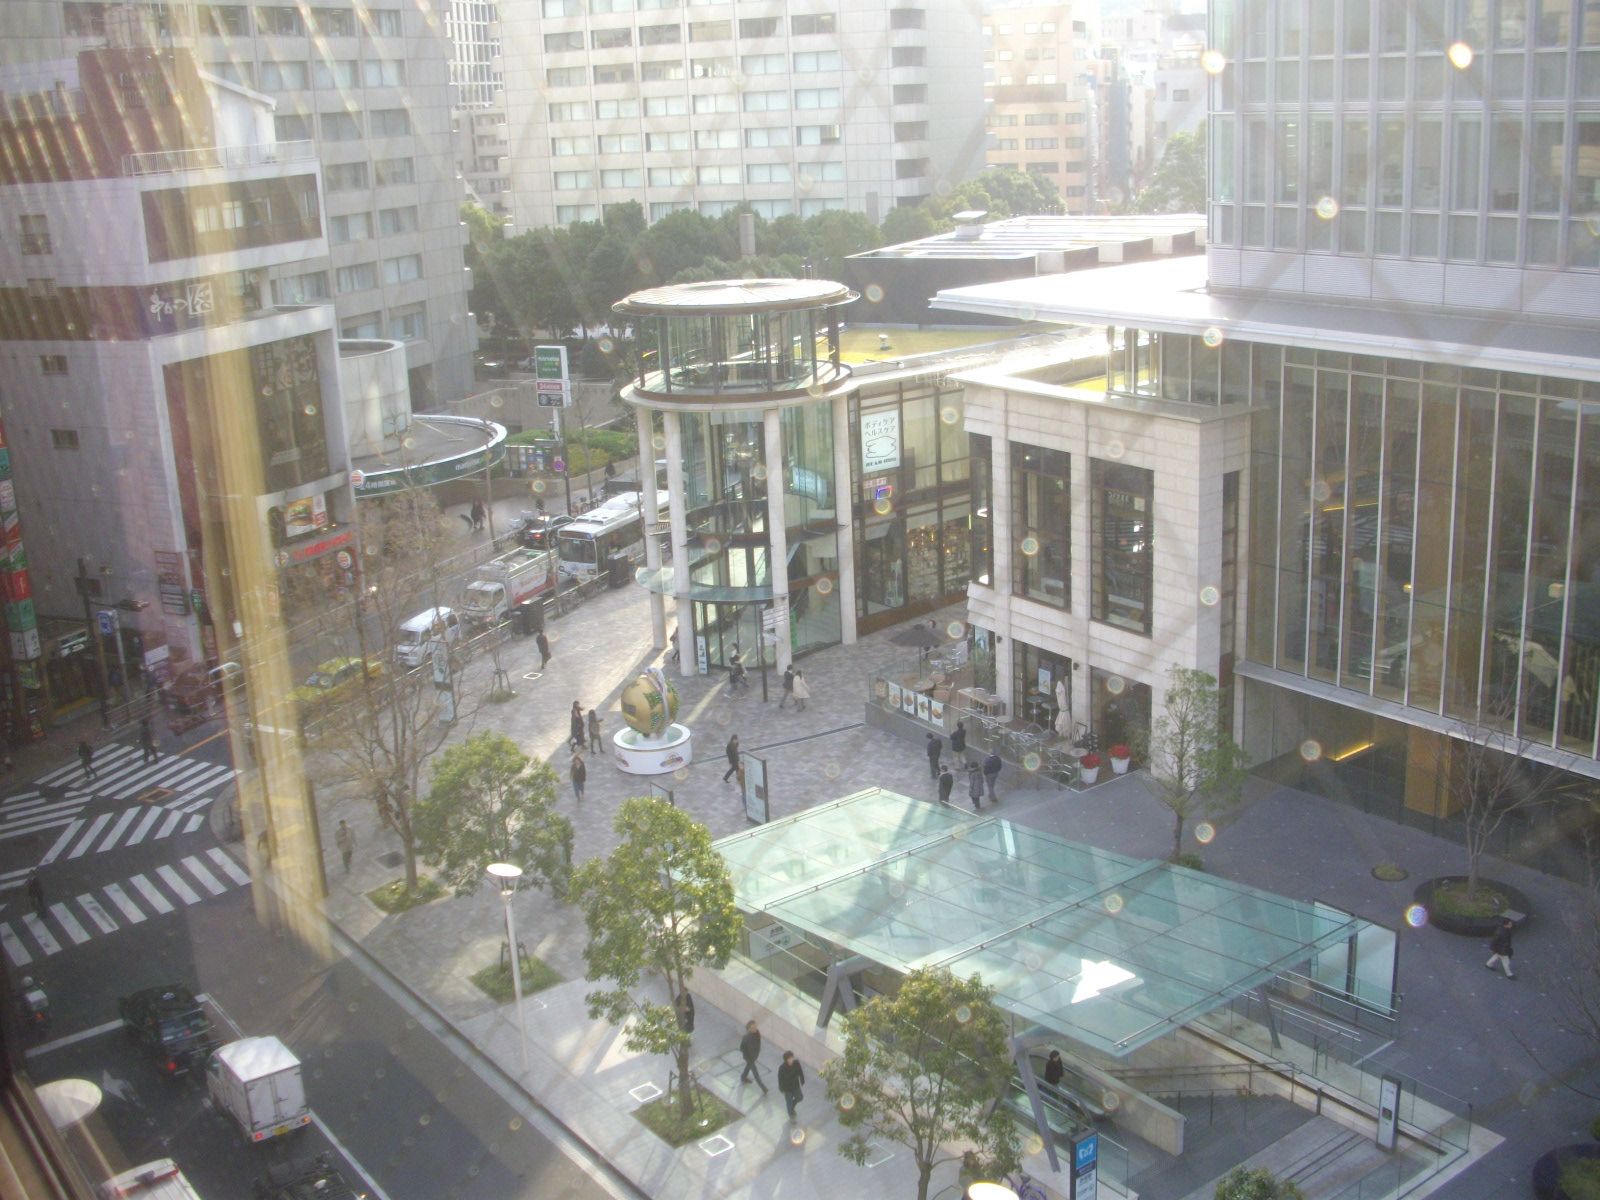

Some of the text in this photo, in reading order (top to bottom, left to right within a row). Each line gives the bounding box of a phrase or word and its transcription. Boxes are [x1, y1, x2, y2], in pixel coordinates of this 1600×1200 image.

[865, 425, 896, 437] ヘルスケア
